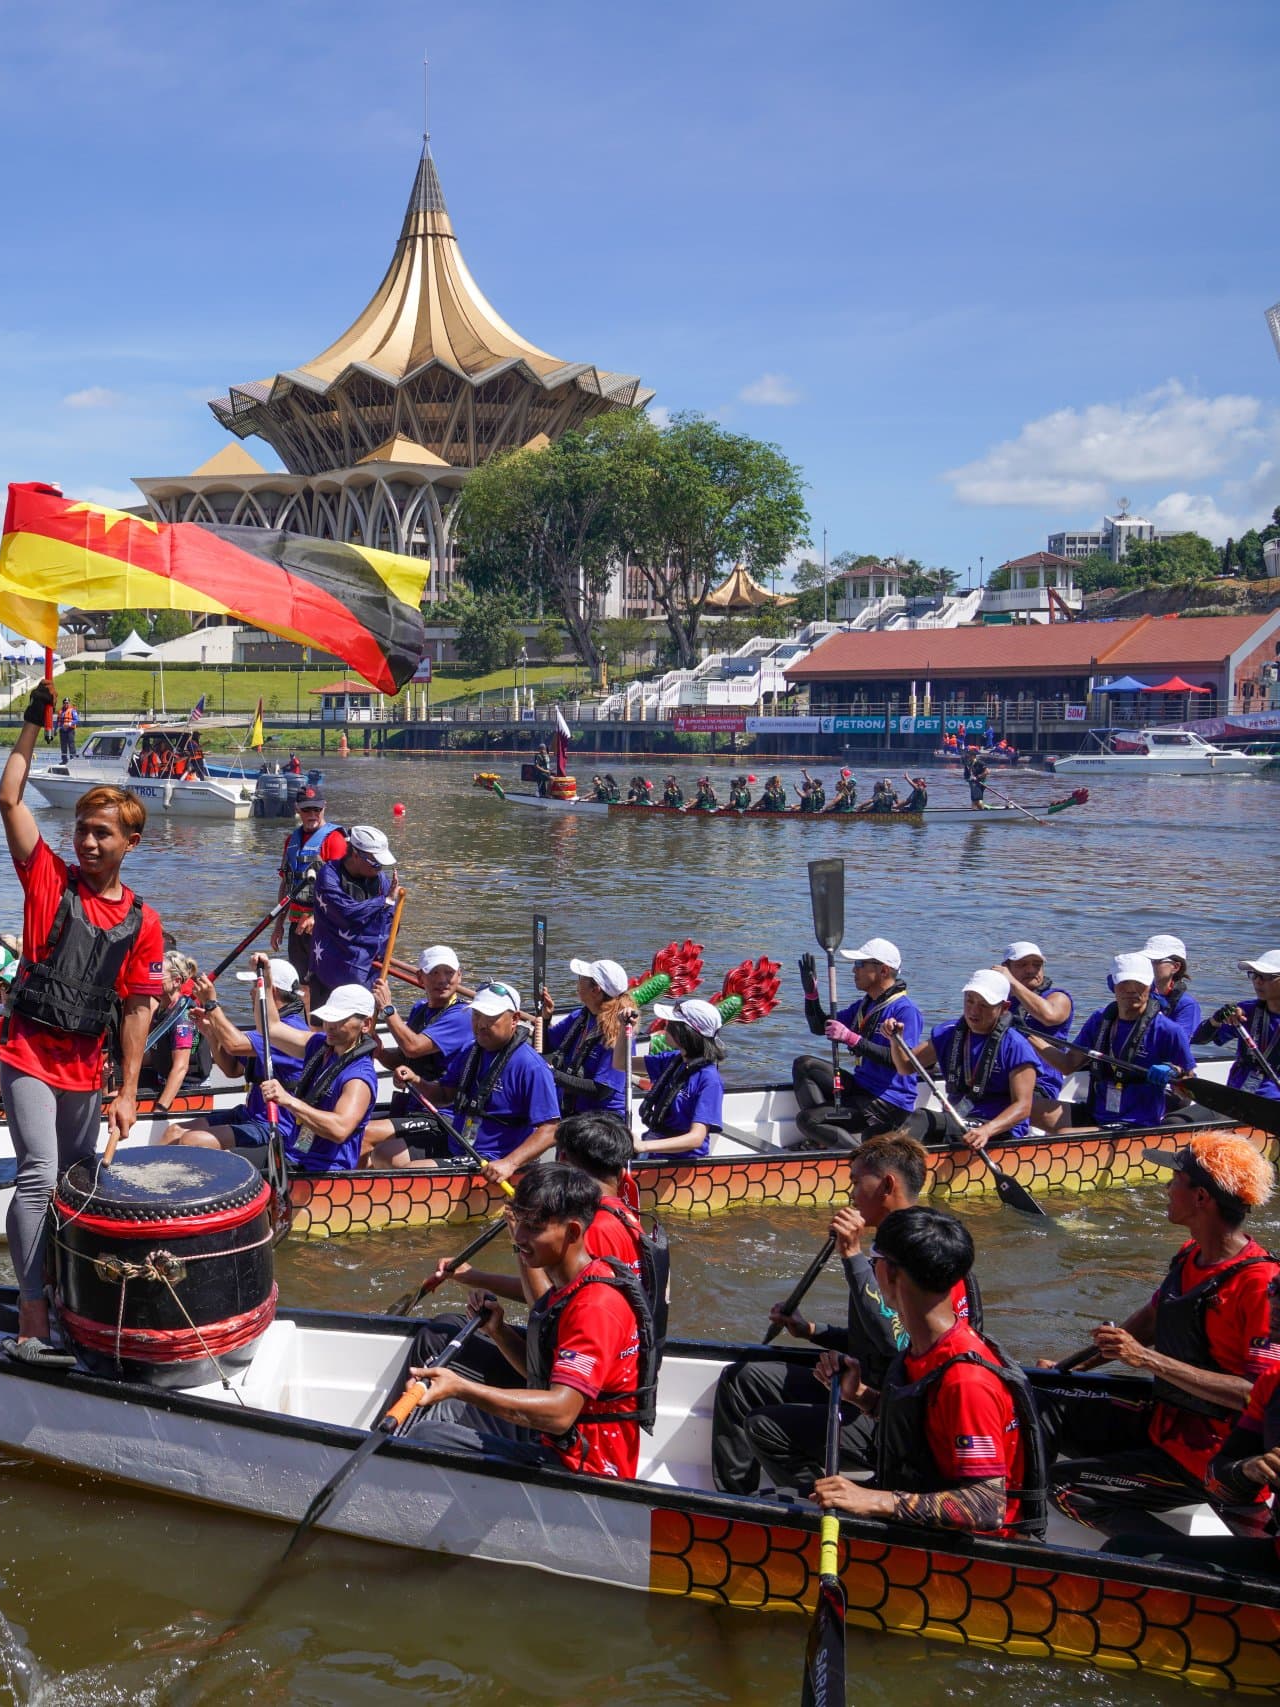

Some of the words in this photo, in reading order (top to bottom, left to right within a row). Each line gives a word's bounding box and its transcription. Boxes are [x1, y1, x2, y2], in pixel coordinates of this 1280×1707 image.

[1067, 708, 1083, 718] 50M
[917, 719, 982, 729] PETONAS
[815, 1647, 828, 1707] SARA
